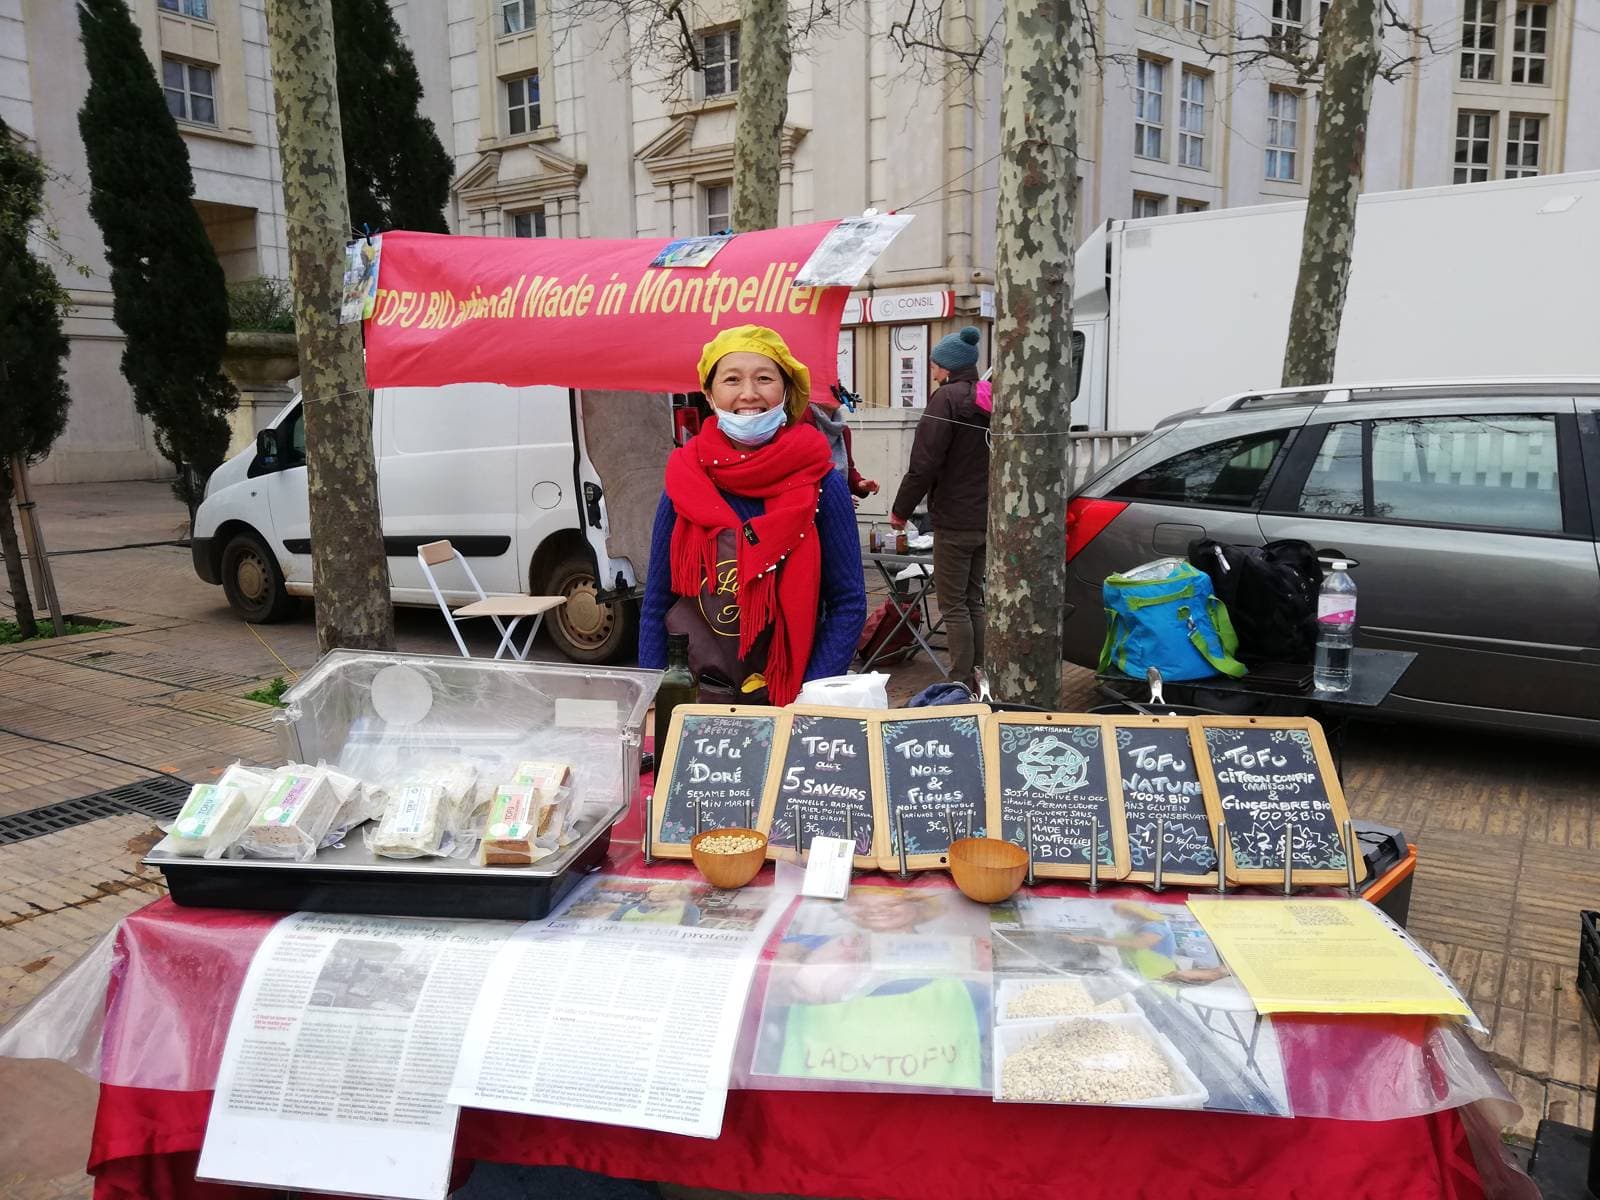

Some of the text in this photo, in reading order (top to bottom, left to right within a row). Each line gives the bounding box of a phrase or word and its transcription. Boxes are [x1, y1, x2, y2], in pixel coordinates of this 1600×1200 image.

[371, 289, 425, 328] TOFU
[417, 289, 456, 329] BIO
[521, 273, 595, 318] Made
[595, 272, 628, 315] in
[629, 262, 831, 326] Montpellier
[783, 767, 866, 801] 5 SAVEURS
[927, 776, 943, 790] &
[1122, 773, 1203, 795] NATURE
[1003, 788, 1029, 798] SOJA
[1130, 791, 1166, 803] 100%
[1268, 790, 1279, 801] &
[786, 804, 821, 814] LARIER,
[1124, 800, 1187, 812] ANS GLUTEN
[820, 815, 848, 823] GIROFL
[1126, 811, 1146, 820] ANS
[1050, 817, 1105, 828] ARTISANL
[1032, 824, 1061, 833] MADE
